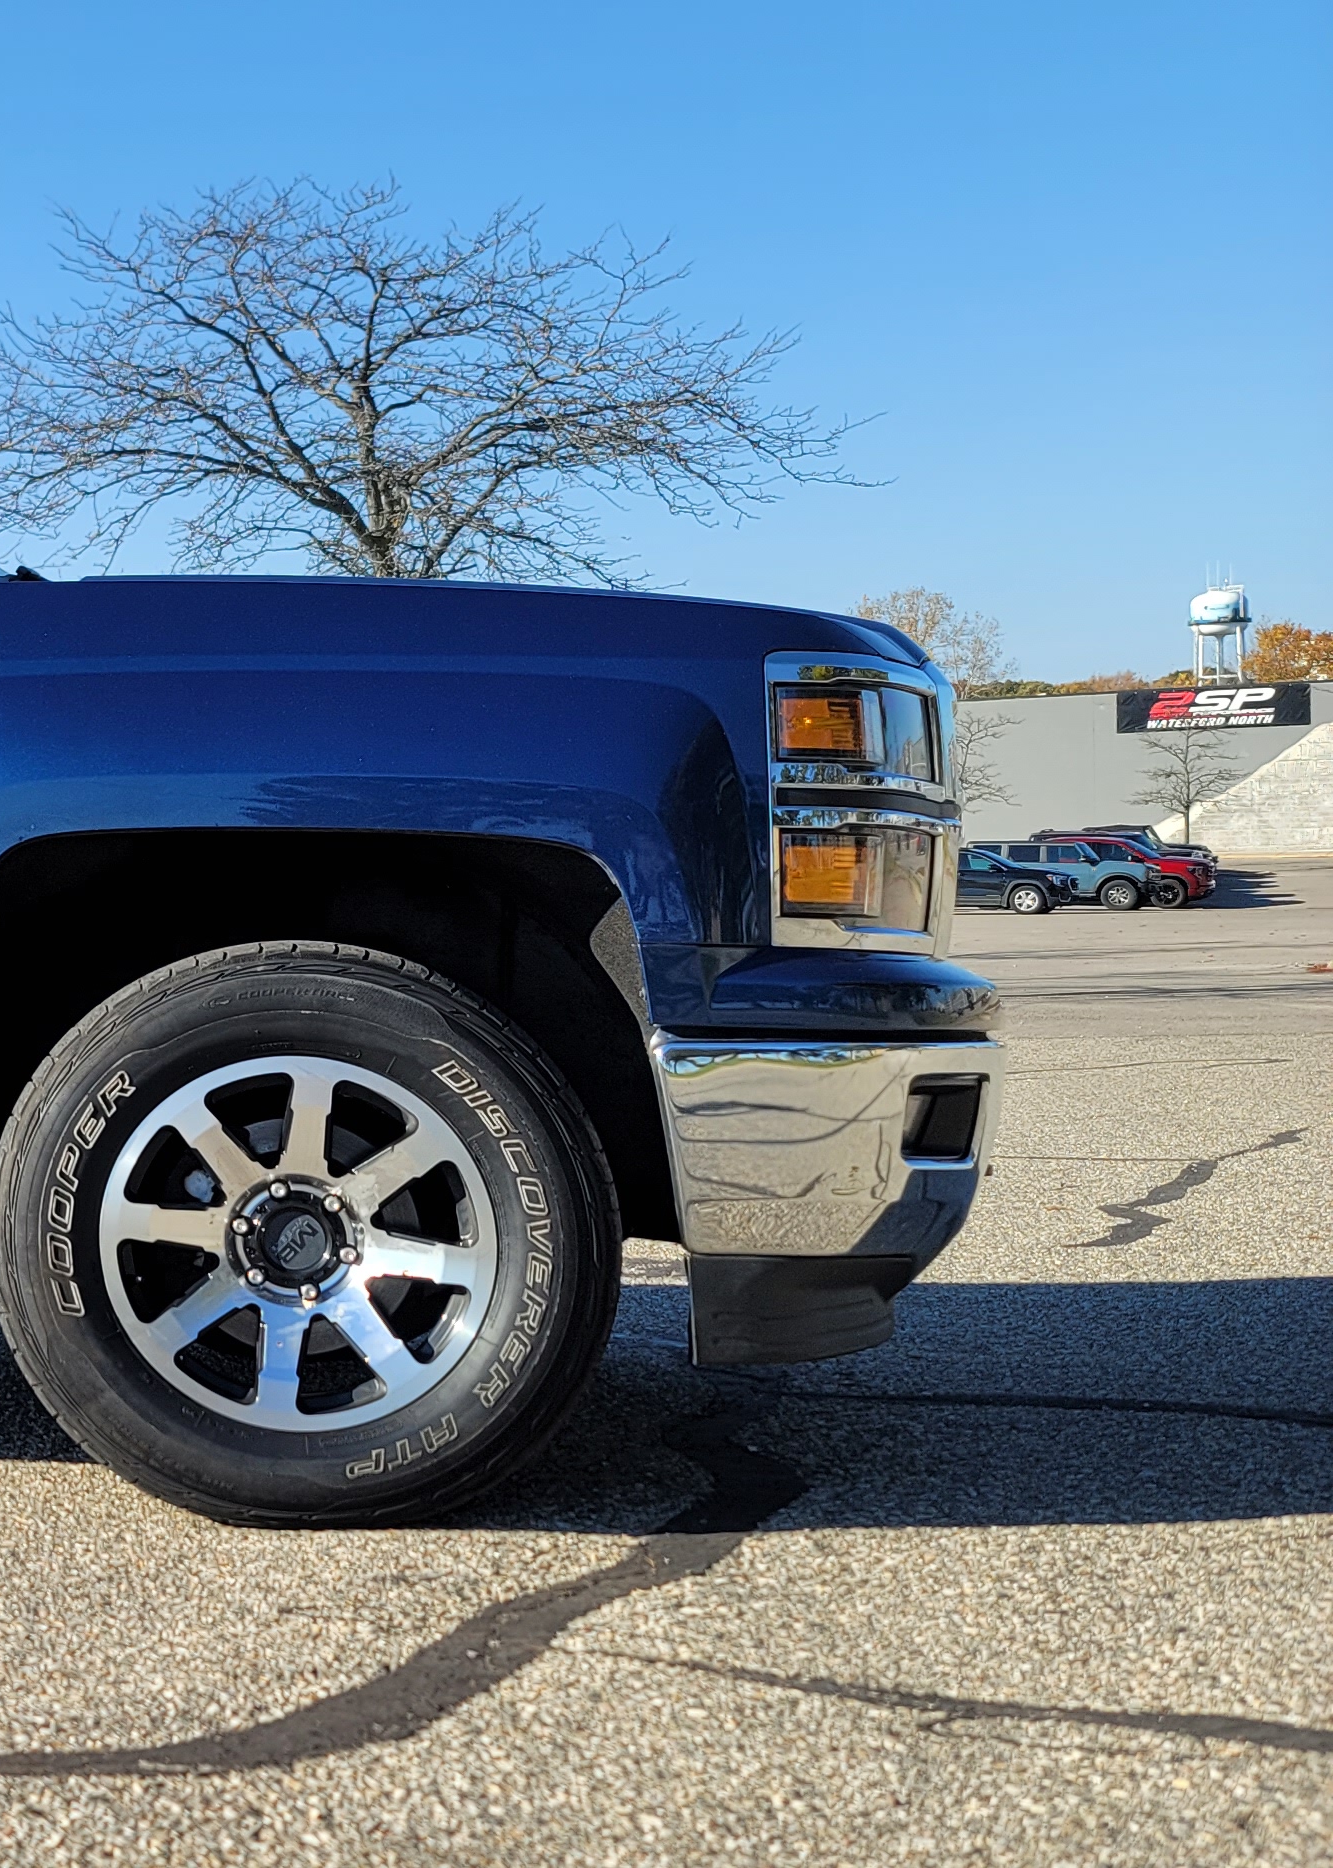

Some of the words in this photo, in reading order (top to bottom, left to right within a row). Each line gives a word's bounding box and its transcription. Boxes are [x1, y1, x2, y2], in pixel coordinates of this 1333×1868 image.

[1148, 687, 1276, 717] 2SP
[1227, 714, 1275, 726] NORTH
[42, 1068, 136, 1318] COOPER
[431, 1059, 553, 1408] DISCOVERER
[344, 1412, 461, 1480] ATP
